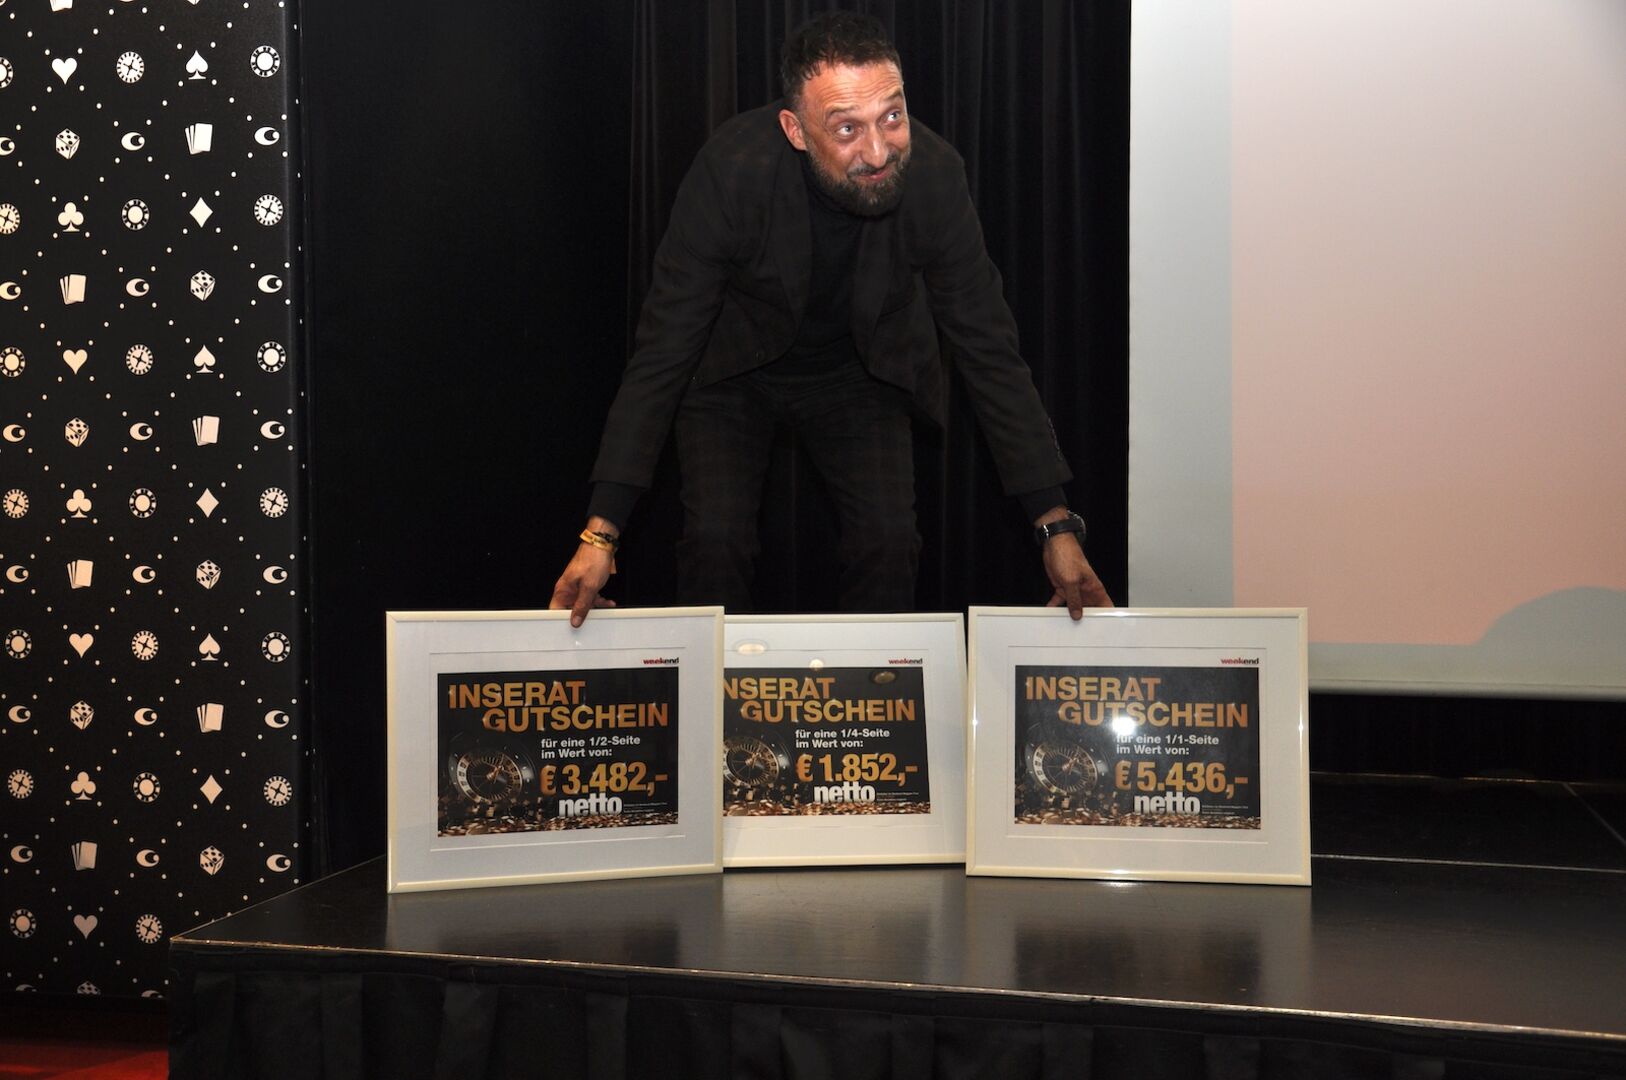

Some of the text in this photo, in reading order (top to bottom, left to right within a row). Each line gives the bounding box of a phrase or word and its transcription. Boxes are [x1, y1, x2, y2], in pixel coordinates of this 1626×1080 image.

[643, 657, 680, 665] weekend
[1220, 657, 1259, 665] weekend
[448, 680, 586, 709] INSERAT
[724, 677, 835, 700] NSERAT
[1025, 676, 1161, 701] INSERAT
[482, 702, 668, 732] GUTSCHEIN
[740, 699, 915, 723] GUTSCHEIN
[1058, 701, 1248, 728] GUTSCHEIN
[541, 735, 641, 748] für eine 1/2-Seite
[795, 728, 890, 738] für eine 1/4-Seite
[796, 739, 864, 748] im Wert von:
[1136, 734, 1161, 744] eine
[1165, 734, 1219, 745] 1/1-Seite
[541, 748, 613, 759] im Wert von:
[1116, 744, 1190, 755] im Wert von:
[540, 761, 668, 796] € 3.482,-
[795, 752, 918, 786] € 1.852,-
[1114, 759, 1248, 799] € 5.436,-
[814, 781, 876, 803] netto
[1134, 791, 1200, 816] netto
[559, 792, 622, 817] netto
